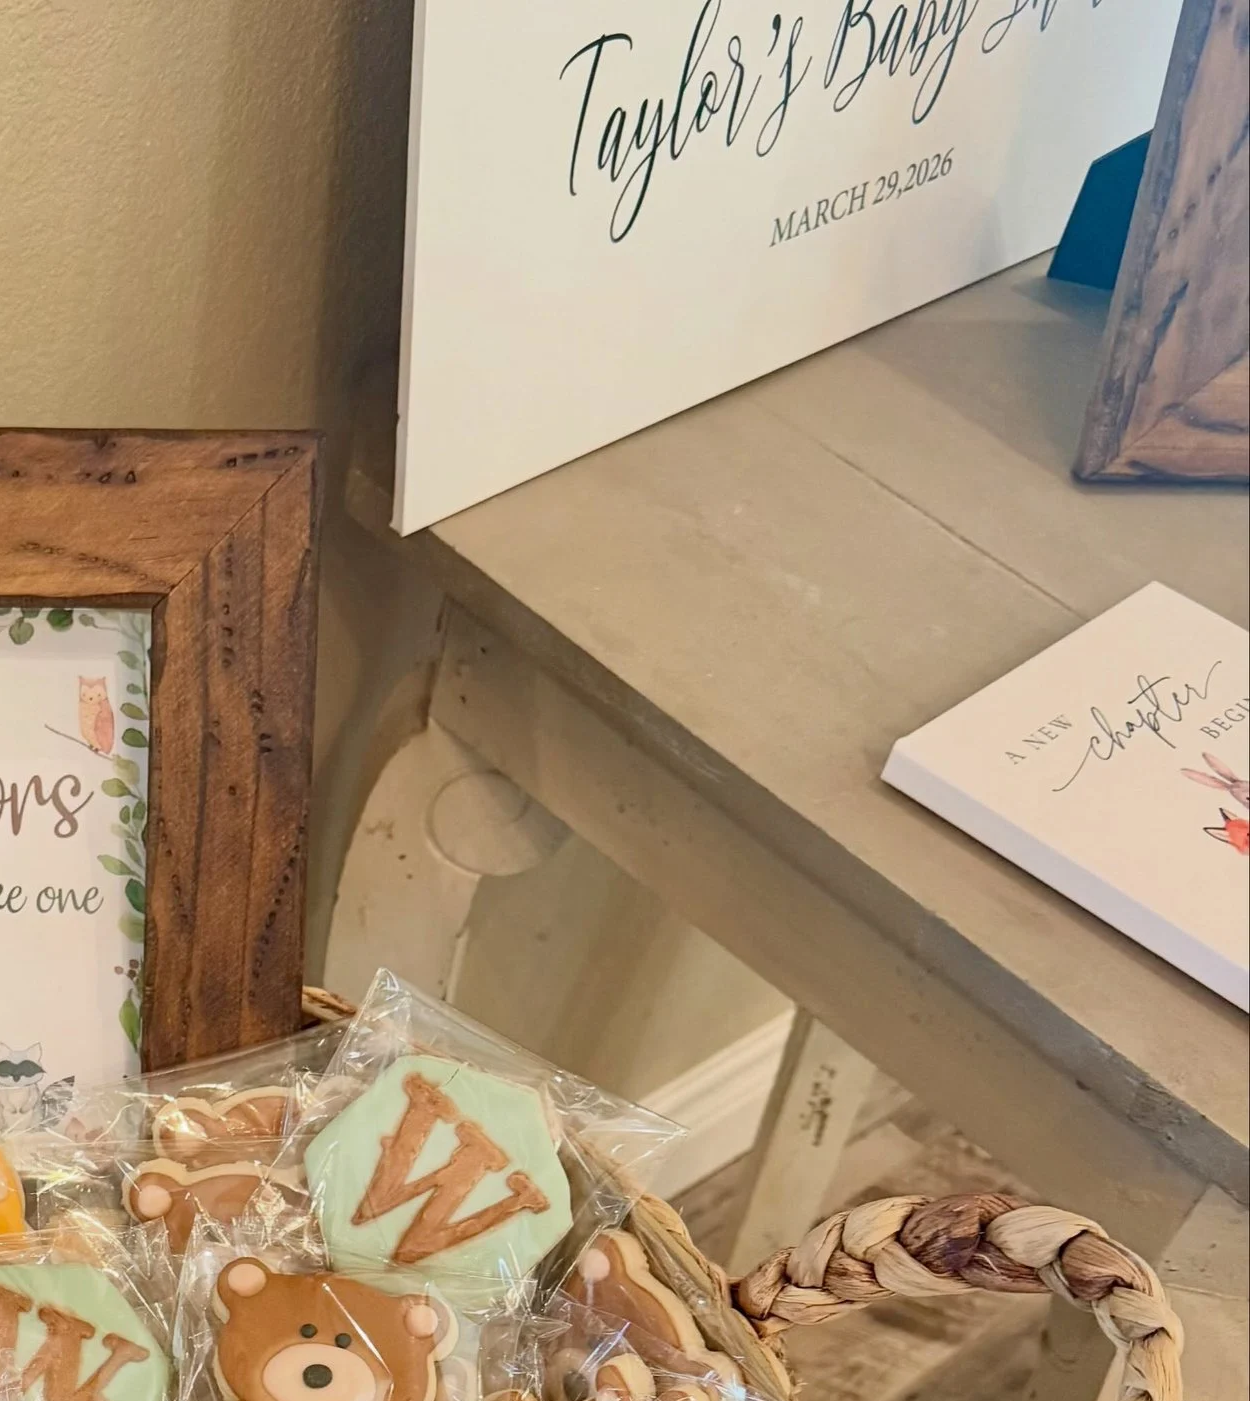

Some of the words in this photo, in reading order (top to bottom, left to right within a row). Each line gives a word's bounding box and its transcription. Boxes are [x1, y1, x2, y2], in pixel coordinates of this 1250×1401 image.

[559, 0, 813, 244] Taylor's
[822, 0, 978, 125] Baby
[768, 180, 870, 248] MARCH
[871, 146, 956, 206] 29,2026
[1004, 749, 1028, 766] A
[1022, 712, 1074, 752] NEW
[1051, 660, 1223, 793] chapter
[1200, 698, 1249, 740] BEGI
[35, 882, 105, 916] one
[351, 1072, 551, 1265] W
